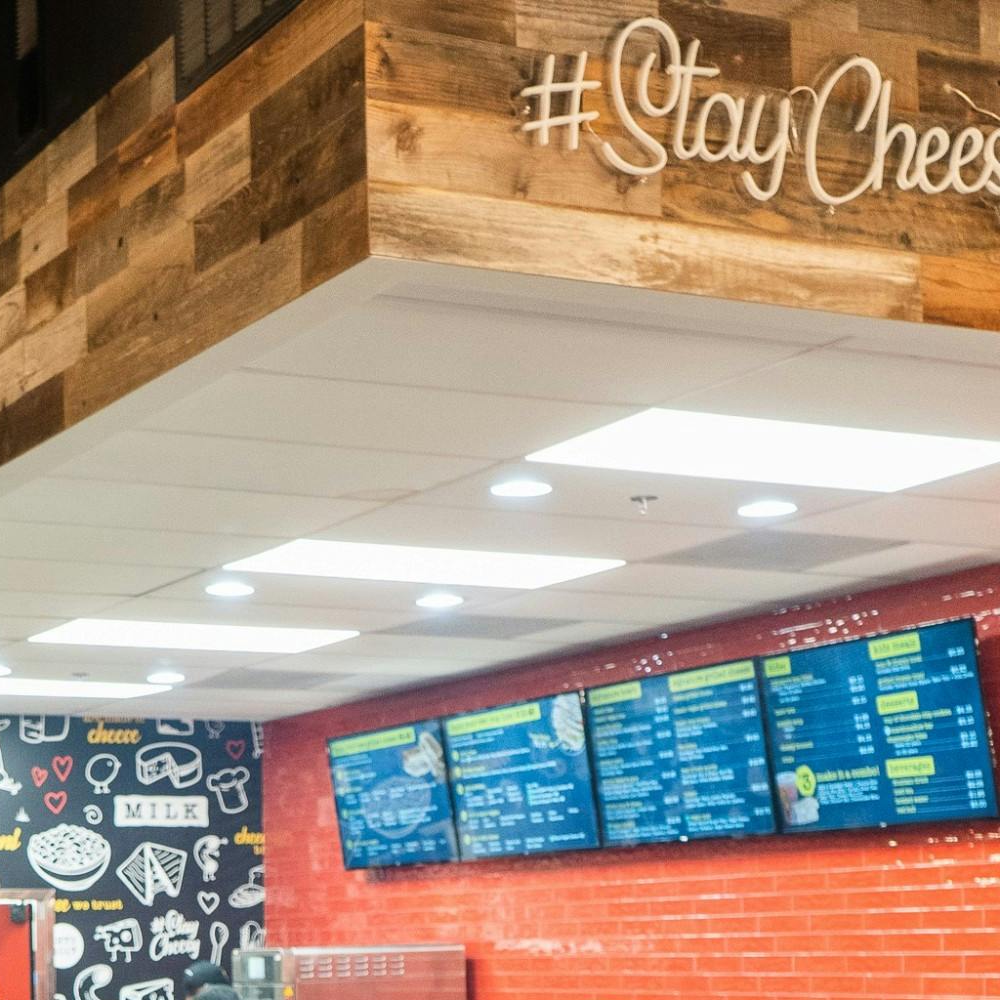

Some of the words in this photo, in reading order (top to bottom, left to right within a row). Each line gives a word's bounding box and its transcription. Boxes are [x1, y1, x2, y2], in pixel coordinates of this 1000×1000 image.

[87, 722, 142, 744] cheese
[803, 775, 812, 792] 3
[124, 802, 199, 820] MILK
